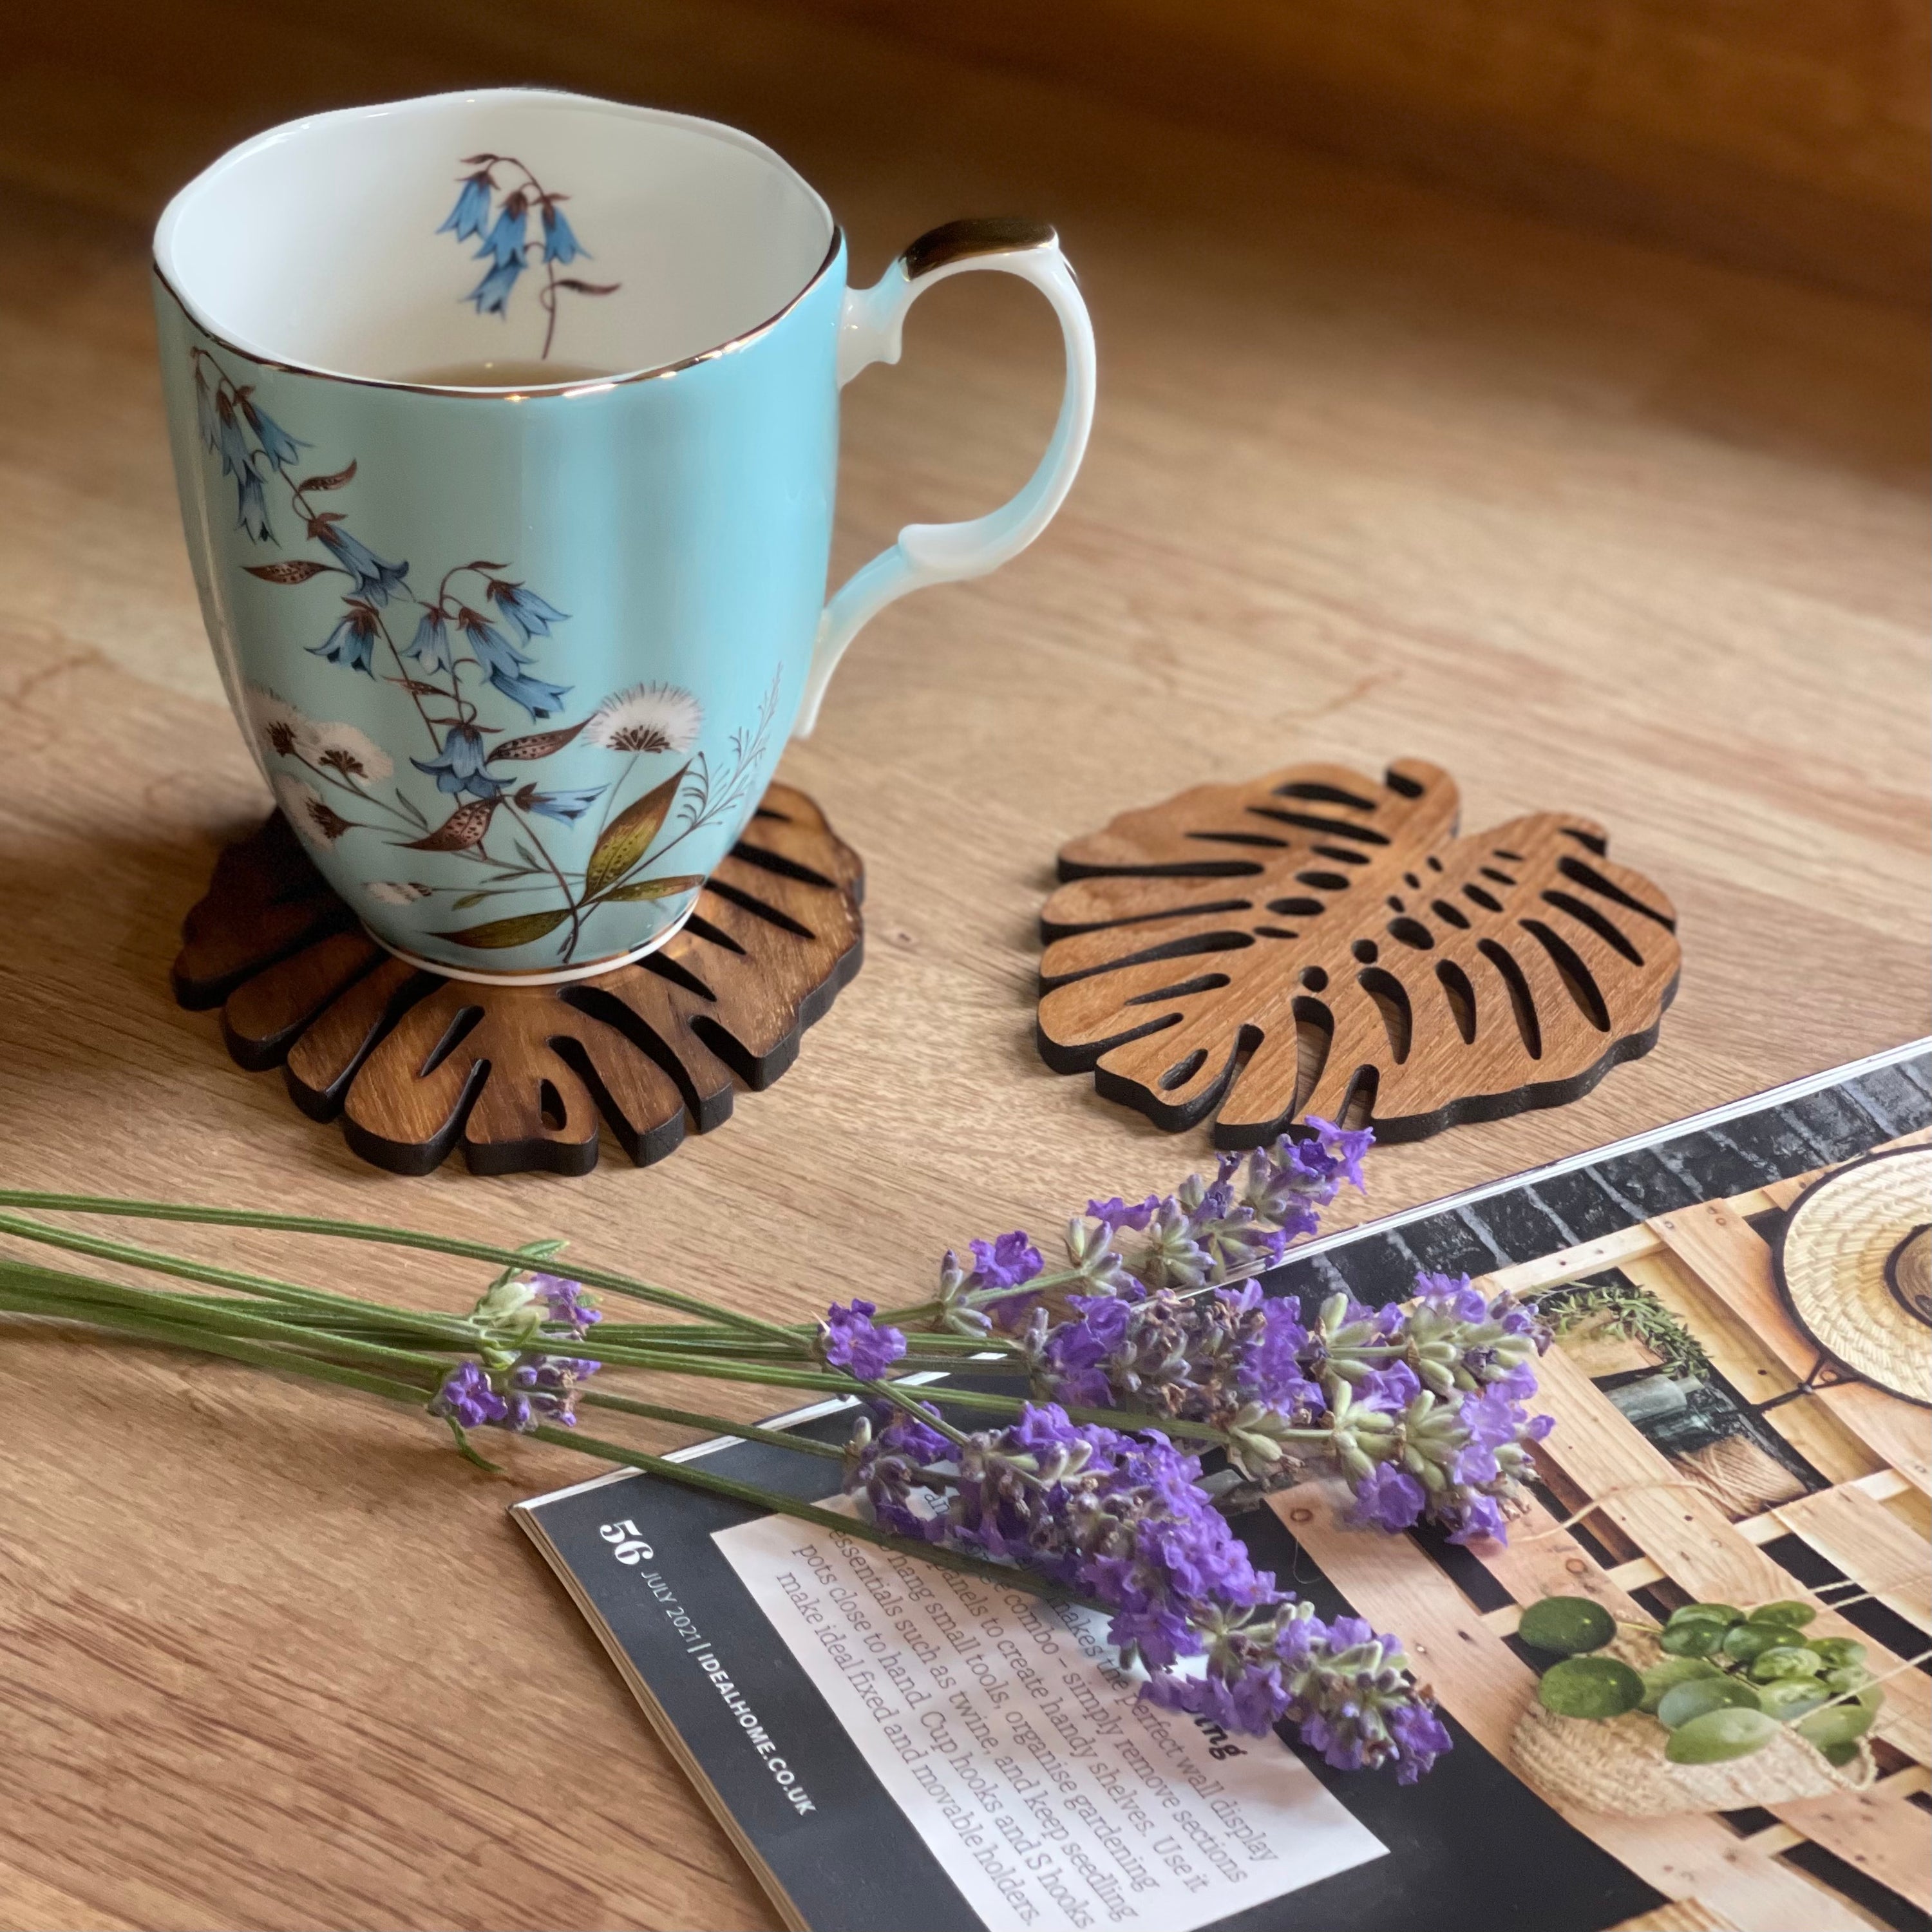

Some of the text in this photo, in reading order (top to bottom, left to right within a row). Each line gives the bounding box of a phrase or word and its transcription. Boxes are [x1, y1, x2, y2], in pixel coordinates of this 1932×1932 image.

[790, 1544, 838, 1586] pots
[828, 1587, 872, 1633] close
[600, 1520, 654, 1565] 56
[641, 1572, 677, 1602] JULY
[666, 1606, 701, 1642] 2021
[697, 1653, 816, 1815] IDEALHOME.CO.UK
[862, 1633, 887, 1654] to
[775, 1571, 1041, 1927] make ideal fixed and movable holders.
[829, 1528, 1139, 1922] essentials such as twine, and keep seedling
[887, 1553, 936, 1602] hang
[923, 1602, 981, 1655] small
[965, 1653, 1010, 1710] tools,
[1005, 1710, 1077, 1794] organise
[1063, 1794, 1160, 1893] gardening
[920, 1710, 959, 1754] Cup
[980, 1617, 1005, 1638] to
[996, 1640, 1050, 1700] create
[1038, 1696, 1099, 1758] handy
[1088, 1762, 1155, 1837] shelves.
[1152, 1835, 1193, 1877] Use
[1182, 1873, 1209, 1893] it
[1003, 1589, 1061, 1655] combo
[1061, 1672, 1124, 1736] simply
[1112, 1738, 1181, 1809] remove
[1171, 1810, 1248, 1883] sections
[948, 1750, 1004, 1814] hooks
[1095, 1658, 1130, 1692] the
[1115, 1692, 1185, 1758] perfect
[1176, 1756, 1225, 1800] wall
[1209, 1799, 1279, 1862] display
[994, 1815, 1043, 1857] and
[1028, 1852, 1054, 1871] S
[1036, 1866, 1095, 1929] hooks
